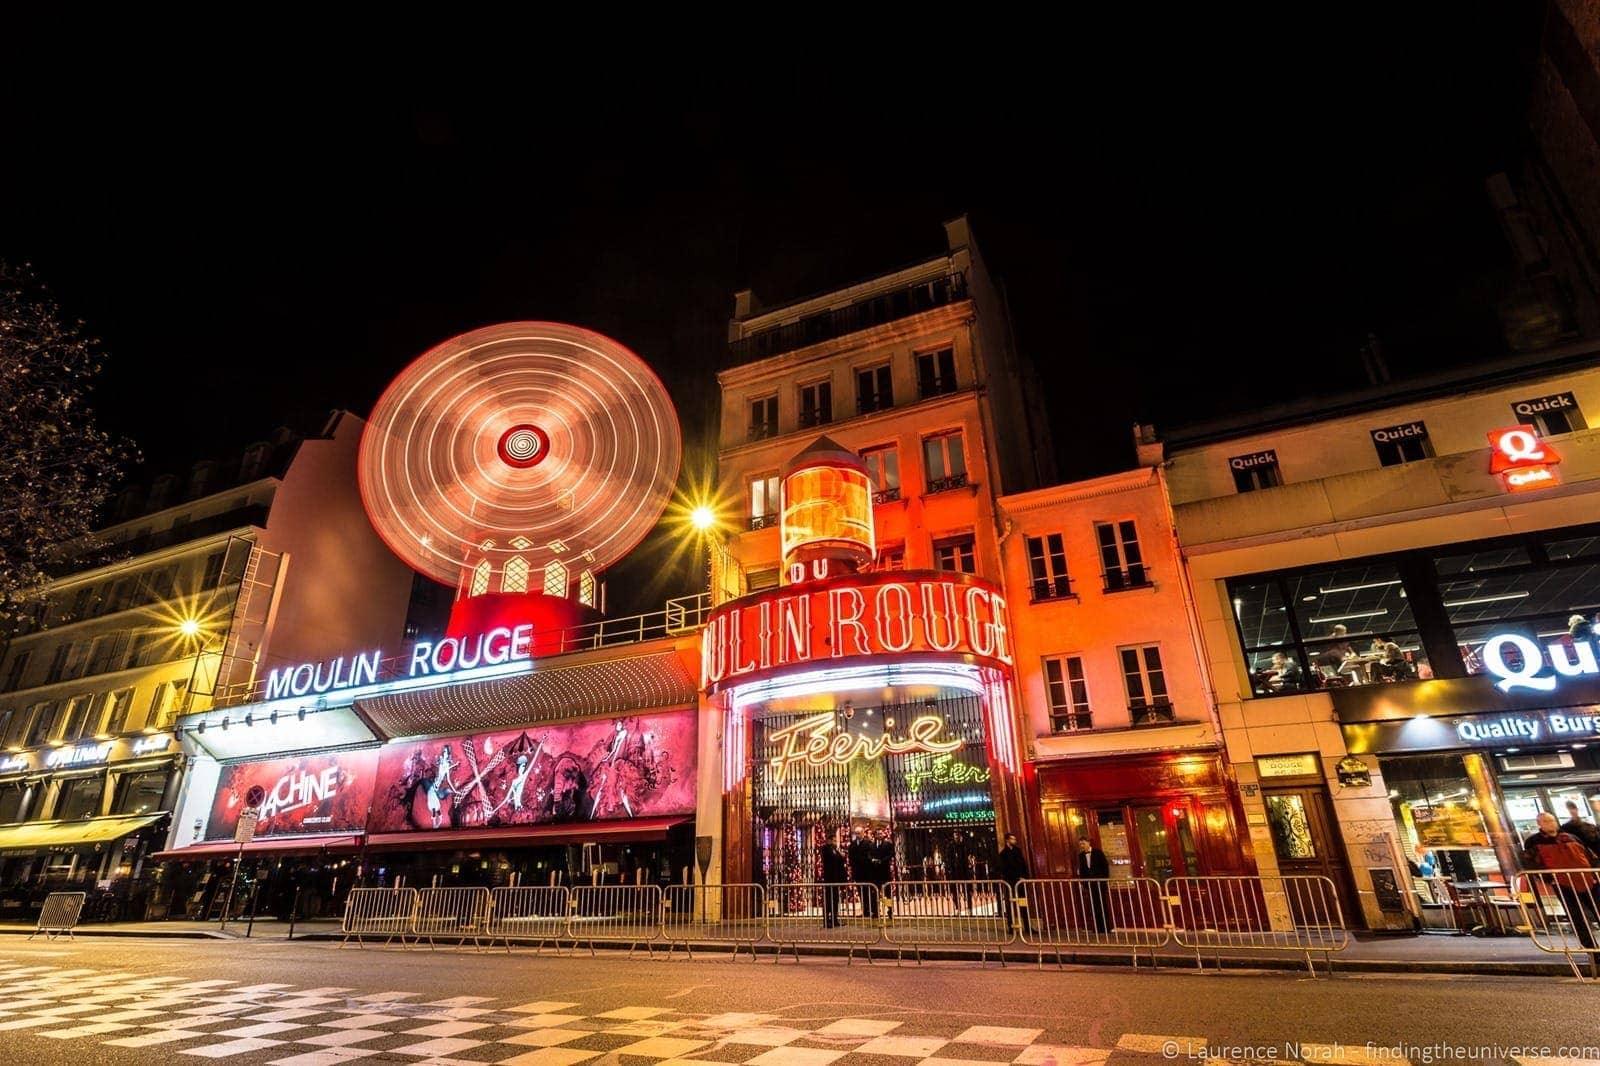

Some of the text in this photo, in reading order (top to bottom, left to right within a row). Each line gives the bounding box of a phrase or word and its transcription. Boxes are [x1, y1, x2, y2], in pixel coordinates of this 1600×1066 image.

[1516, 395, 1572, 415] Quick
[1374, 424, 1425, 443] Quick
[1500, 430, 1545, 463] Q
[1231, 453, 1277, 470] Quick
[790, 558, 828, 583] DU
[702, 582, 1013, 689] ULIN ROUGE
[265, 624, 534, 699] MOULIN ROUGE
[1458, 718, 1539, 741] Quality
